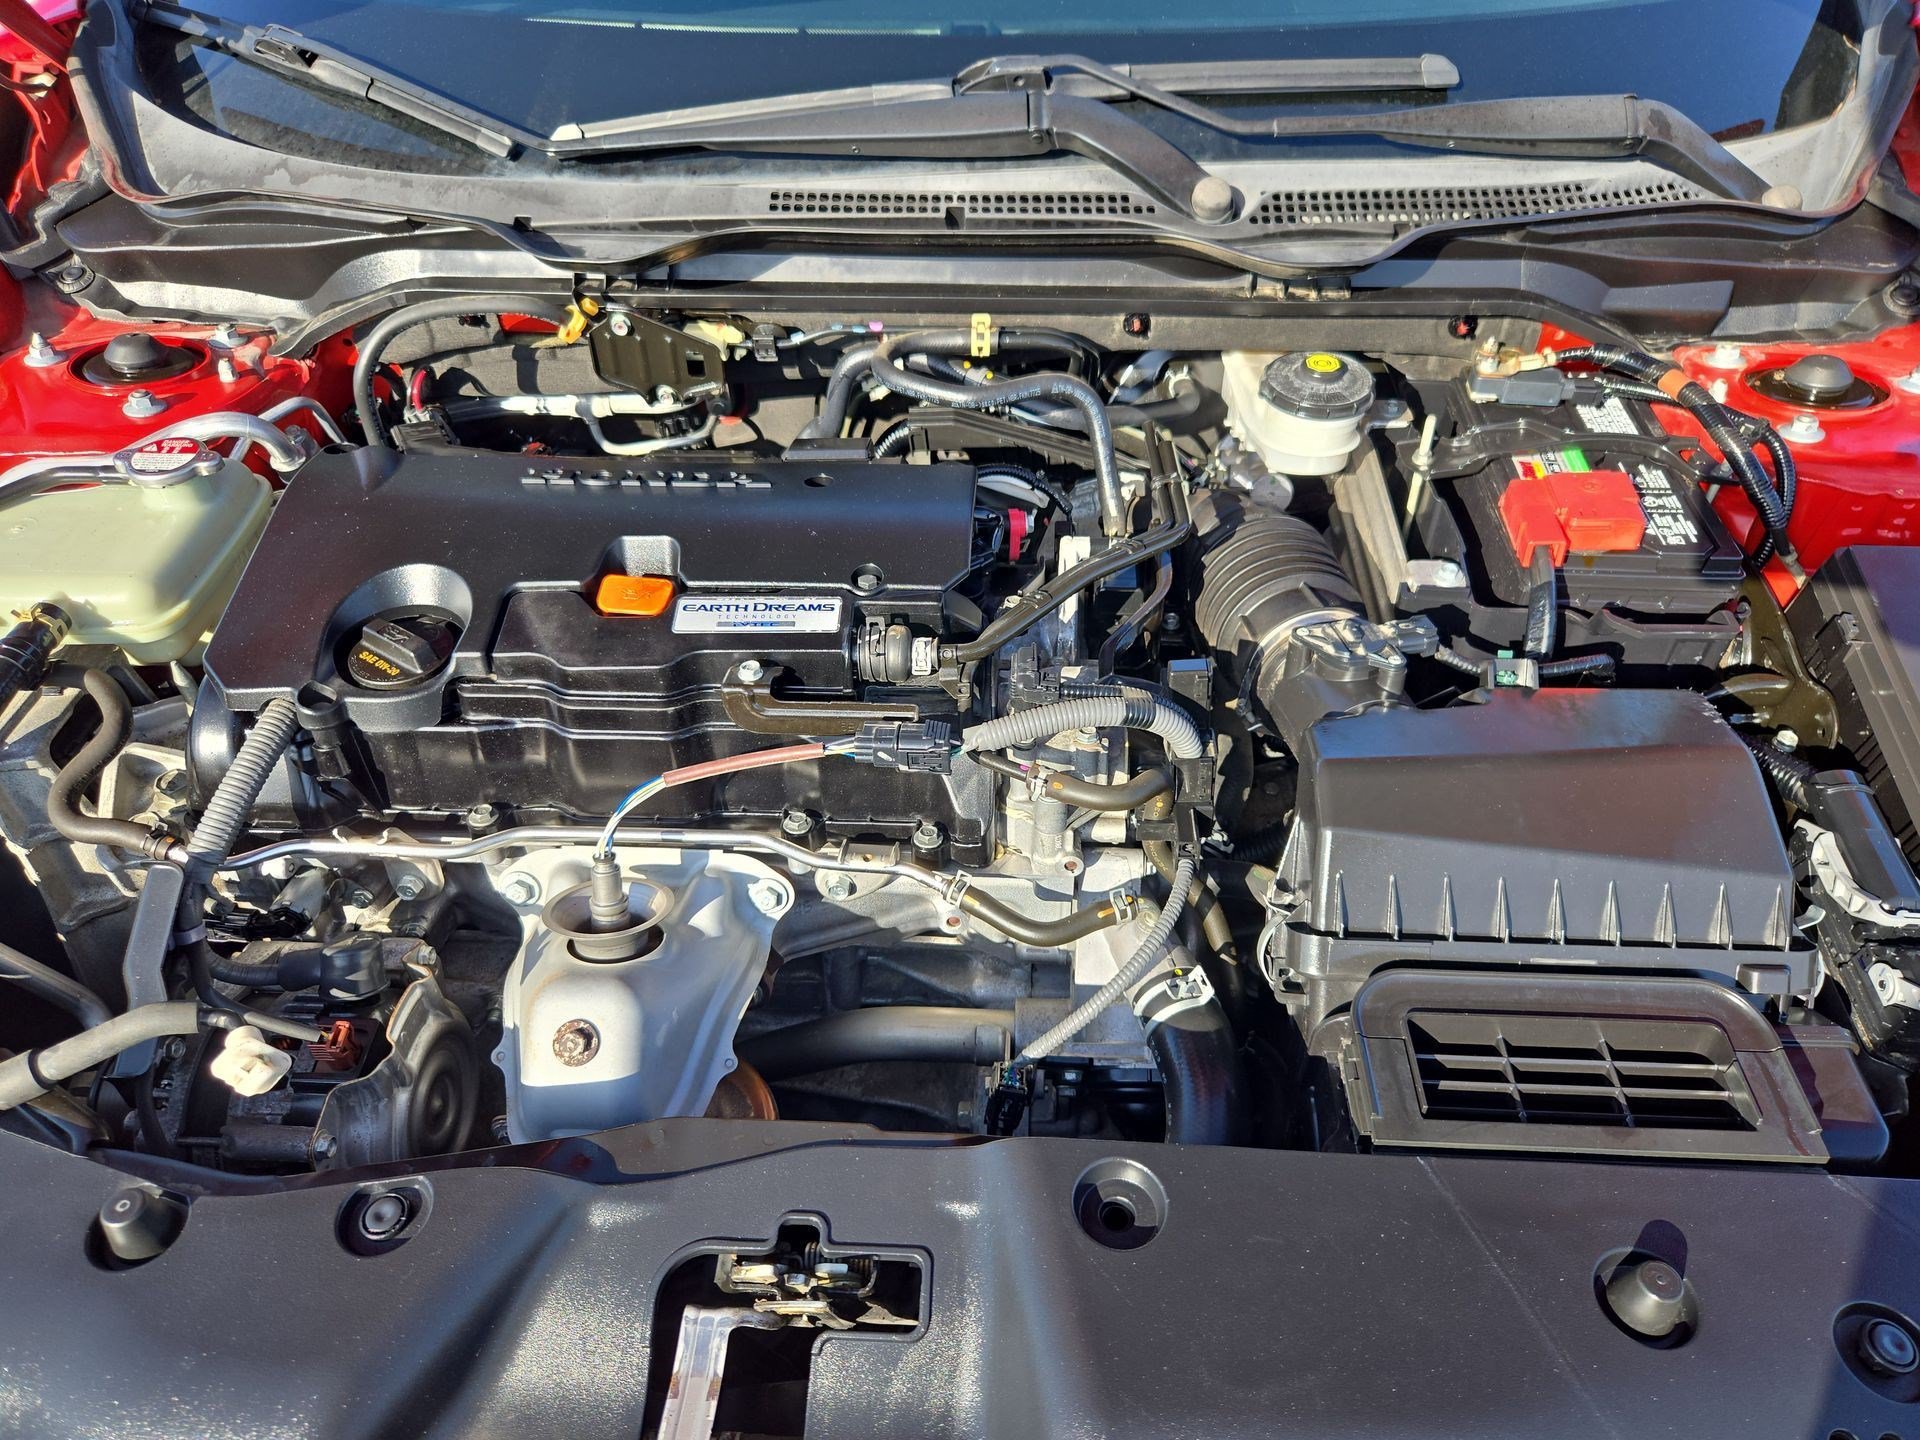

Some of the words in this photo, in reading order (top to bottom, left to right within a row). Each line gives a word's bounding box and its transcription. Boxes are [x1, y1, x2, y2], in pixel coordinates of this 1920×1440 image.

[682, 602, 748, 612] EARTH
[753, 602, 835, 612] DREAMS
[359, 651, 379, 664] SAE
